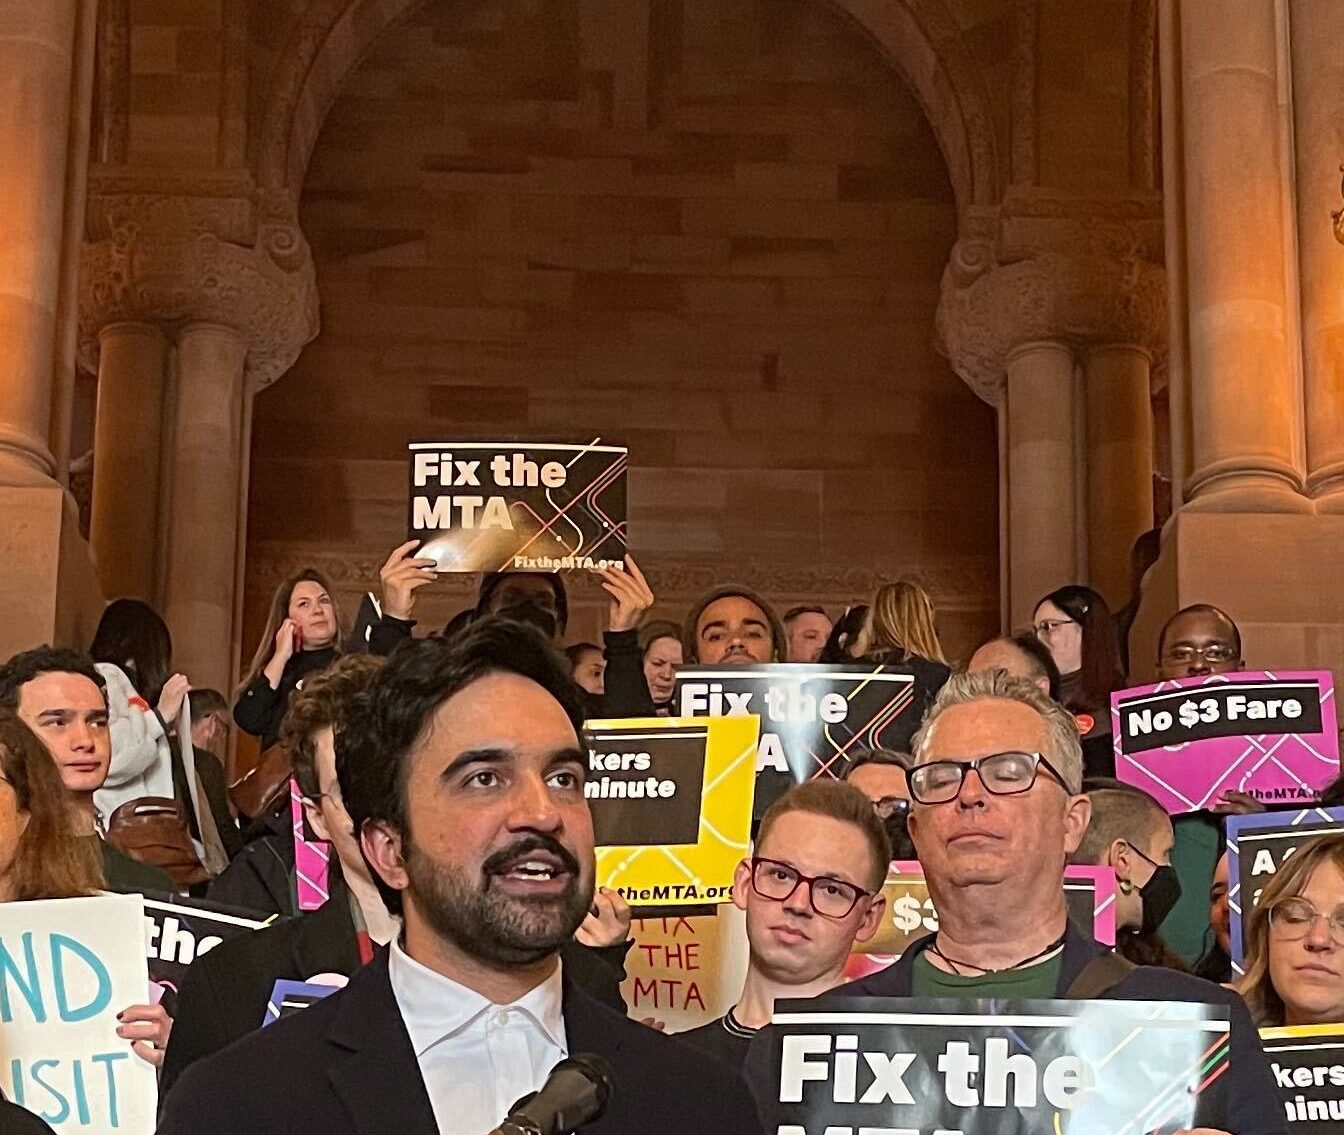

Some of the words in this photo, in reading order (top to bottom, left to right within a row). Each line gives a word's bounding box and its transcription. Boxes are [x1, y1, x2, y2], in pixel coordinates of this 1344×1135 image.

[414, 453, 480, 487] Fix
[490, 453, 567, 488] the
[413, 496, 513, 530] MTA
[681, 683, 753, 717] Fix
[764, 679, 849, 724] the
[1128, 709, 1173, 737] No
[1178, 699, 1220, 729] $3
[1226, 695, 1302, 721] Fare
[589, 749, 651, 771] kers
[1251, 849, 1277, 876] A
[638, 943, 700, 970] THE
[633, 977, 706, 1011] MTA
[779, 1034, 916, 1106] Fix
[938, 1037, 1095, 1109] the
